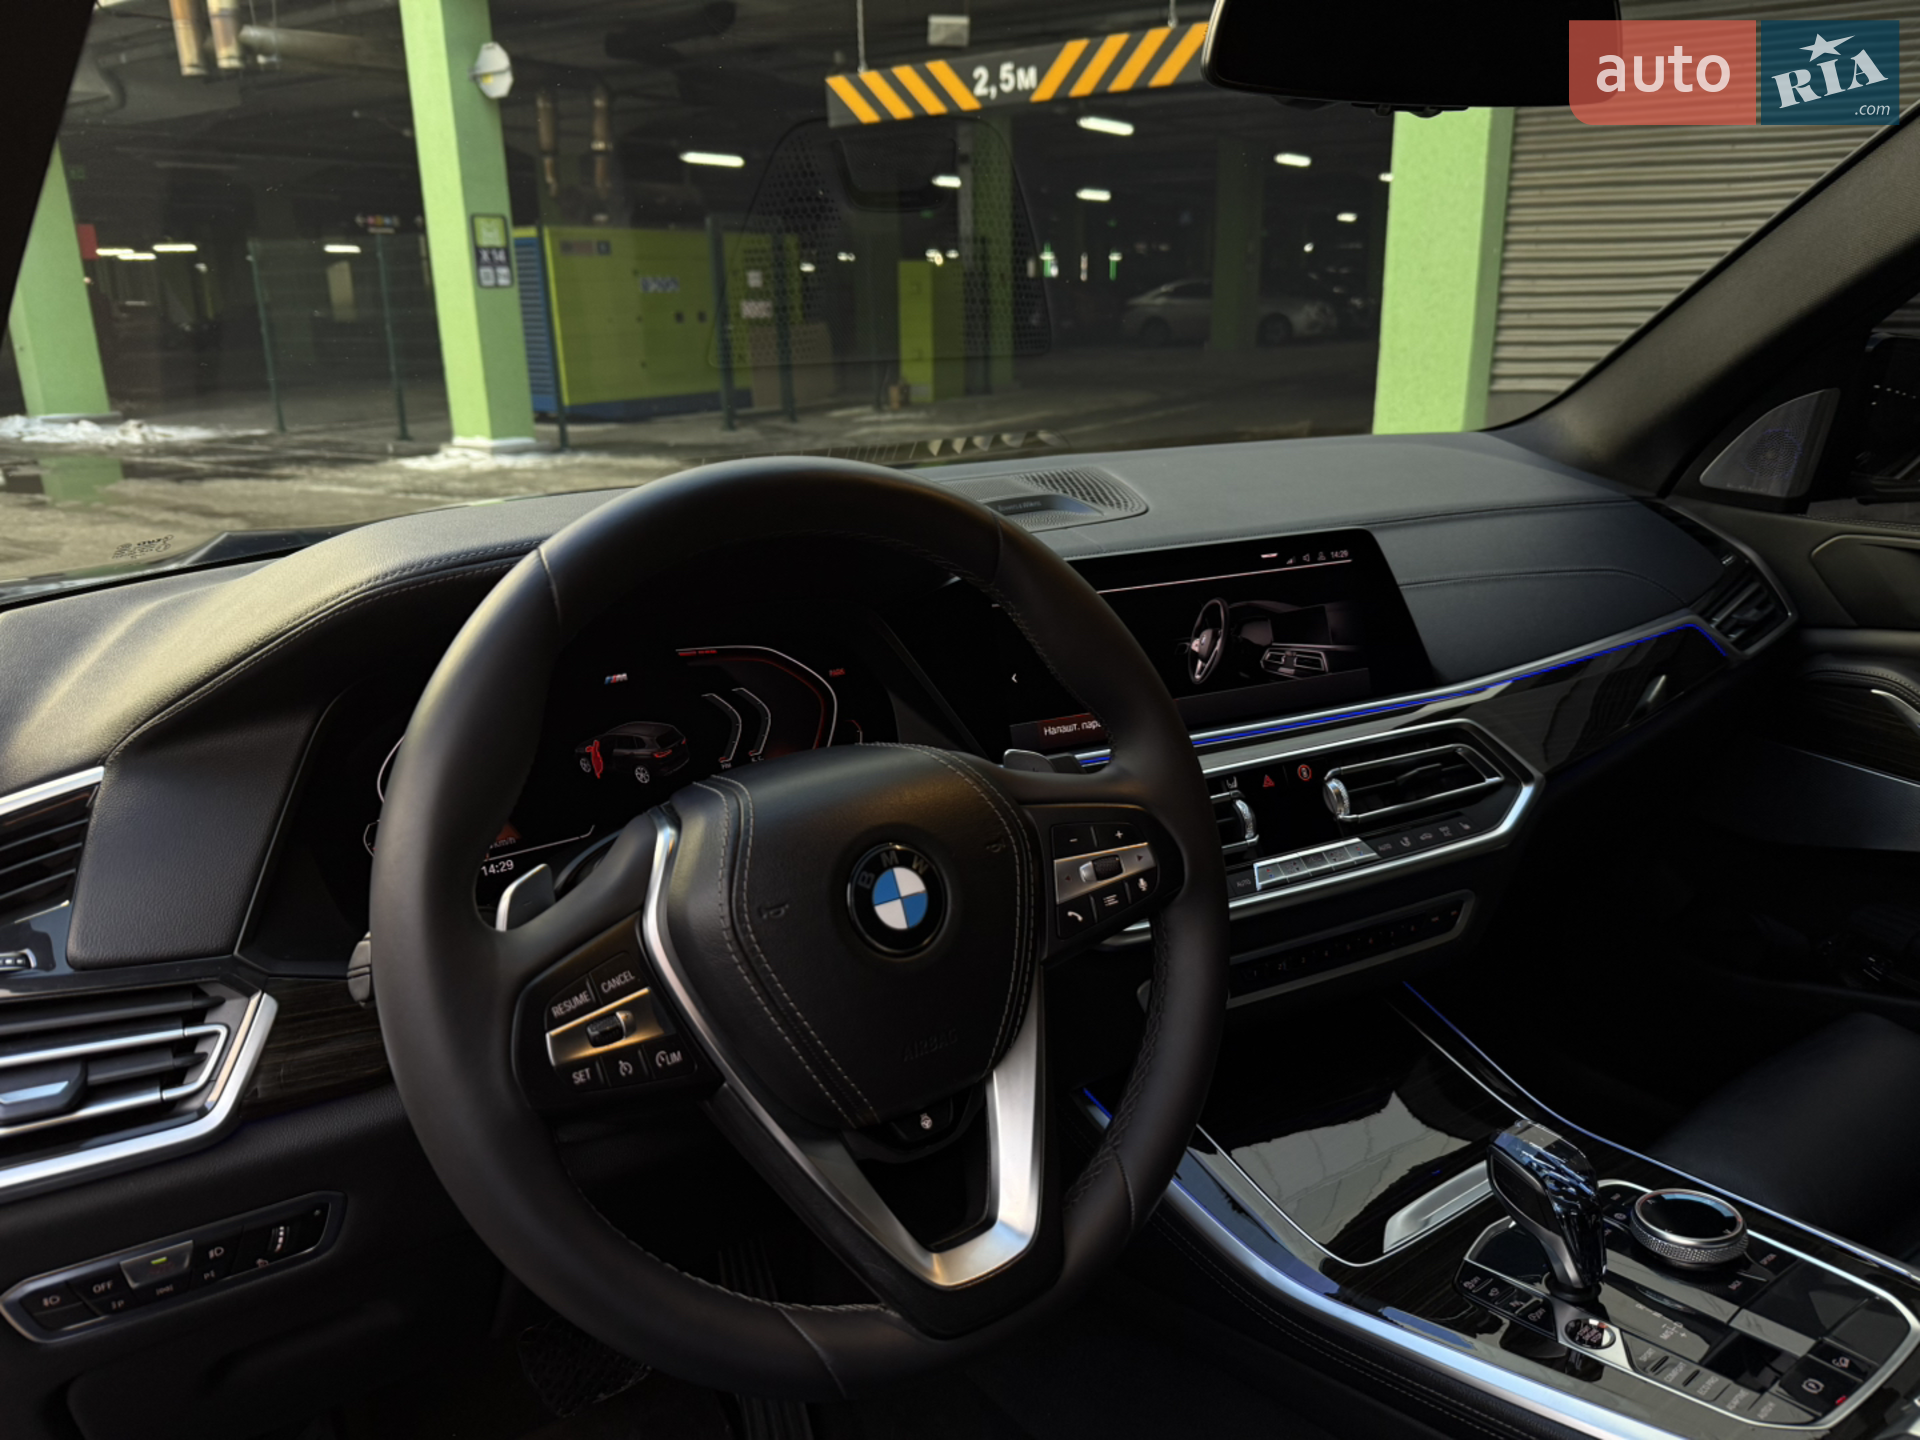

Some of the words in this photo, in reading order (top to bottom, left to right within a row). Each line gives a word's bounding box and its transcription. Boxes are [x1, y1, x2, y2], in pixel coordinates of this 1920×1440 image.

[481, 859, 515, 877] 14:29
[600, 970, 635, 994] CANCEL
[551, 990, 591, 1019] RESUME
[572, 1067, 592, 1085] SET
[92, 1280, 113, 1294] OFF
